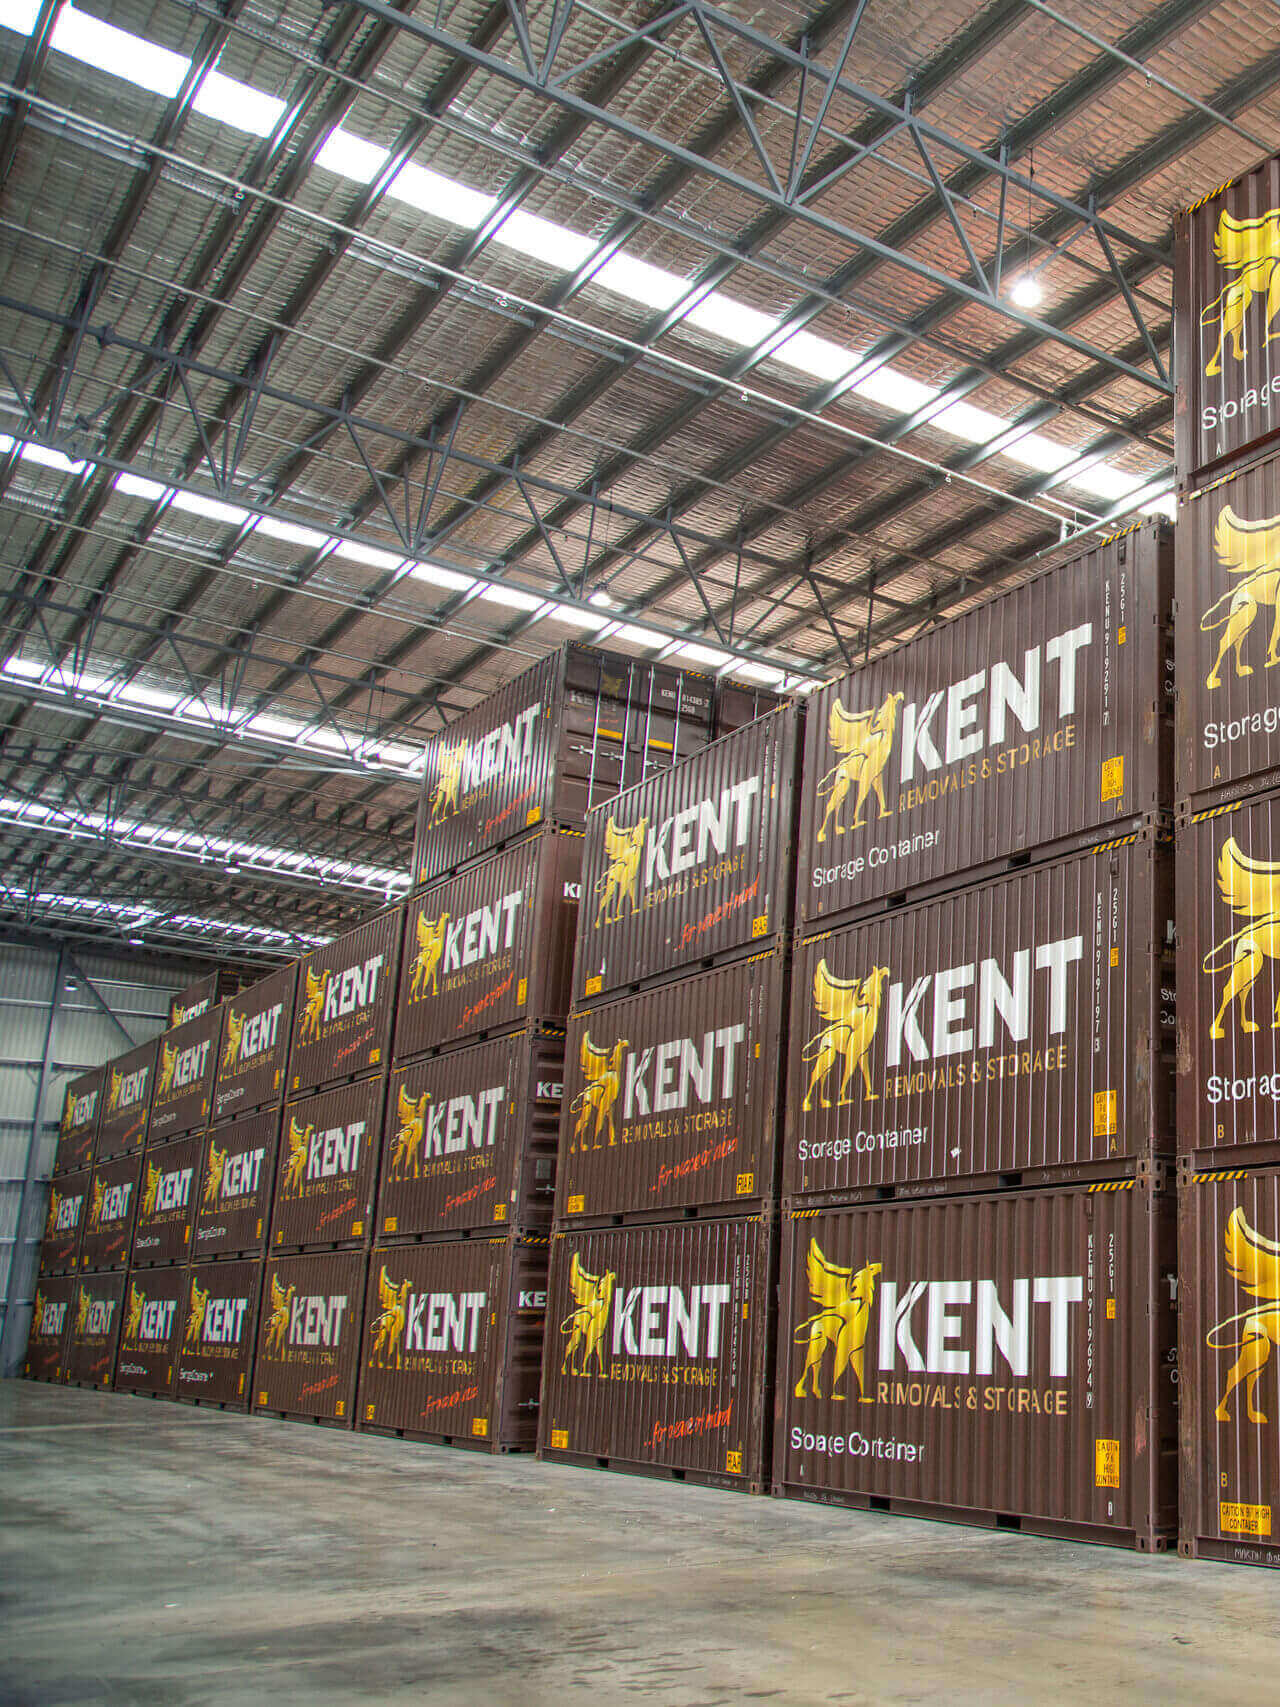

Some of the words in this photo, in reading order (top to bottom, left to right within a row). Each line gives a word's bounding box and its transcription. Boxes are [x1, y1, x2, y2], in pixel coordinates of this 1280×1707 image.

[899, 622, 1092, 784] KENT
[463, 702, 541, 794] KENT
[898, 764, 976, 815] REMOVALS
[980, 758, 991, 779] &
[996, 724, 1076, 774] STORAGE
[645, 776, 759, 888] KENT
[812, 857, 864, 887] Storage
[868, 828, 941, 868] Container
[443, 890, 522, 974] KENT
[323, 954, 384, 1022] KENT
[886, 935, 1083, 1068] KENT
[240, 1003, 283, 1060] KENT
[118, 1066, 148, 1108] KENT
[172, 1040, 210, 1089] KENT
[624, 1023, 744, 1119] KENT
[885, 1062, 967, 1099] REMOVALS
[970, 1061, 981, 1083] &
[987, 1045, 1067, 1081] STORAGE
[73, 1091, 98, 1127] KENT
[424, 1086, 505, 1159] KENT
[1217, 1123, 1225, 1139] B
[306, 1121, 366, 1180] KENT
[798, 1136, 851, 1161] Storage
[855, 1125, 928, 1153] Container
[155, 1168, 194, 1212] KENT
[221, 1149, 265, 1199] KENT
[56, 1195, 83, 1231] KENT
[100, 1183, 133, 1222] KENT
[41, 1302, 68, 1336] KENT
[139, 1300, 177, 1340] KENT
[202, 1299, 248, 1344] KENT
[289, 1296, 347, 1346] KENT
[406, 1292, 486, 1352] KENT
[612, 1284, 730, 1358] KENT
[878, 1276, 1083, 1377] KENT
[966, 1386, 977, 1410] &
[984, 1387, 1068, 1415] STORAGE
[1220, 1472, 1228, 1488] B
